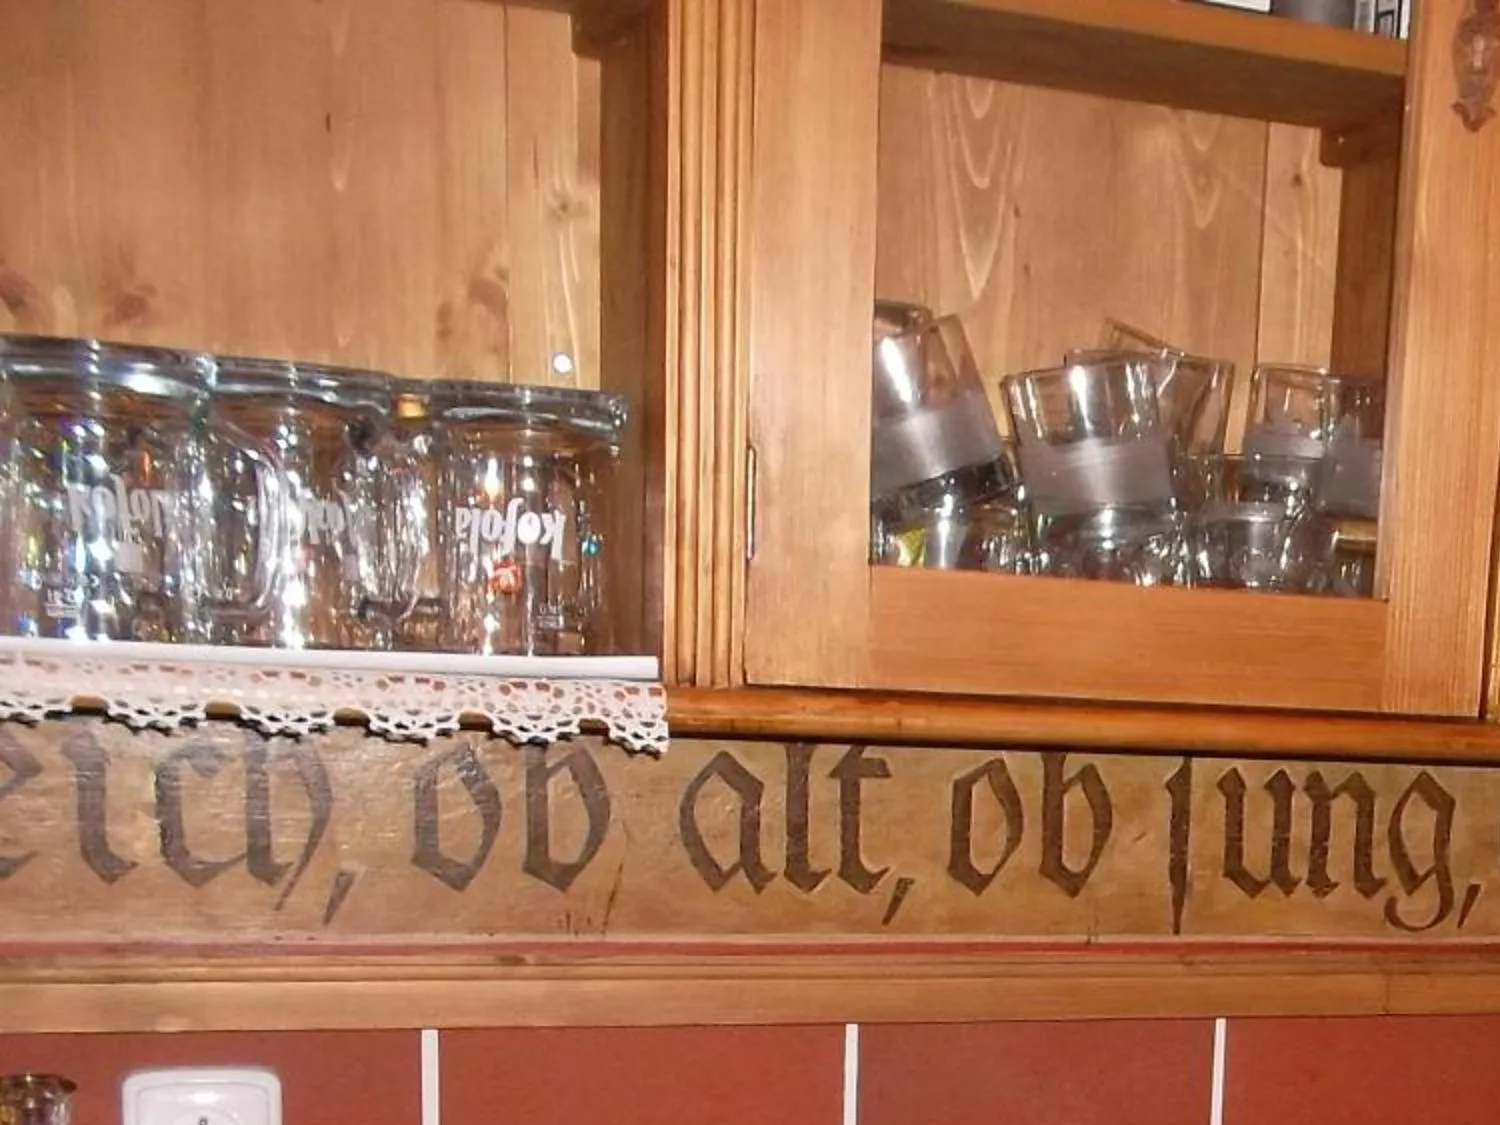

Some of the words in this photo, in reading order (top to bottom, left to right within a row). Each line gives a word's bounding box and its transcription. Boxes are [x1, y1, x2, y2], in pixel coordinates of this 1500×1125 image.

[455, 497, 567, 562] kofola
[679, 743, 915, 926] alt,
[947, 751, 1113, 899] ob
[1165, 755, 1483, 936] jung,
